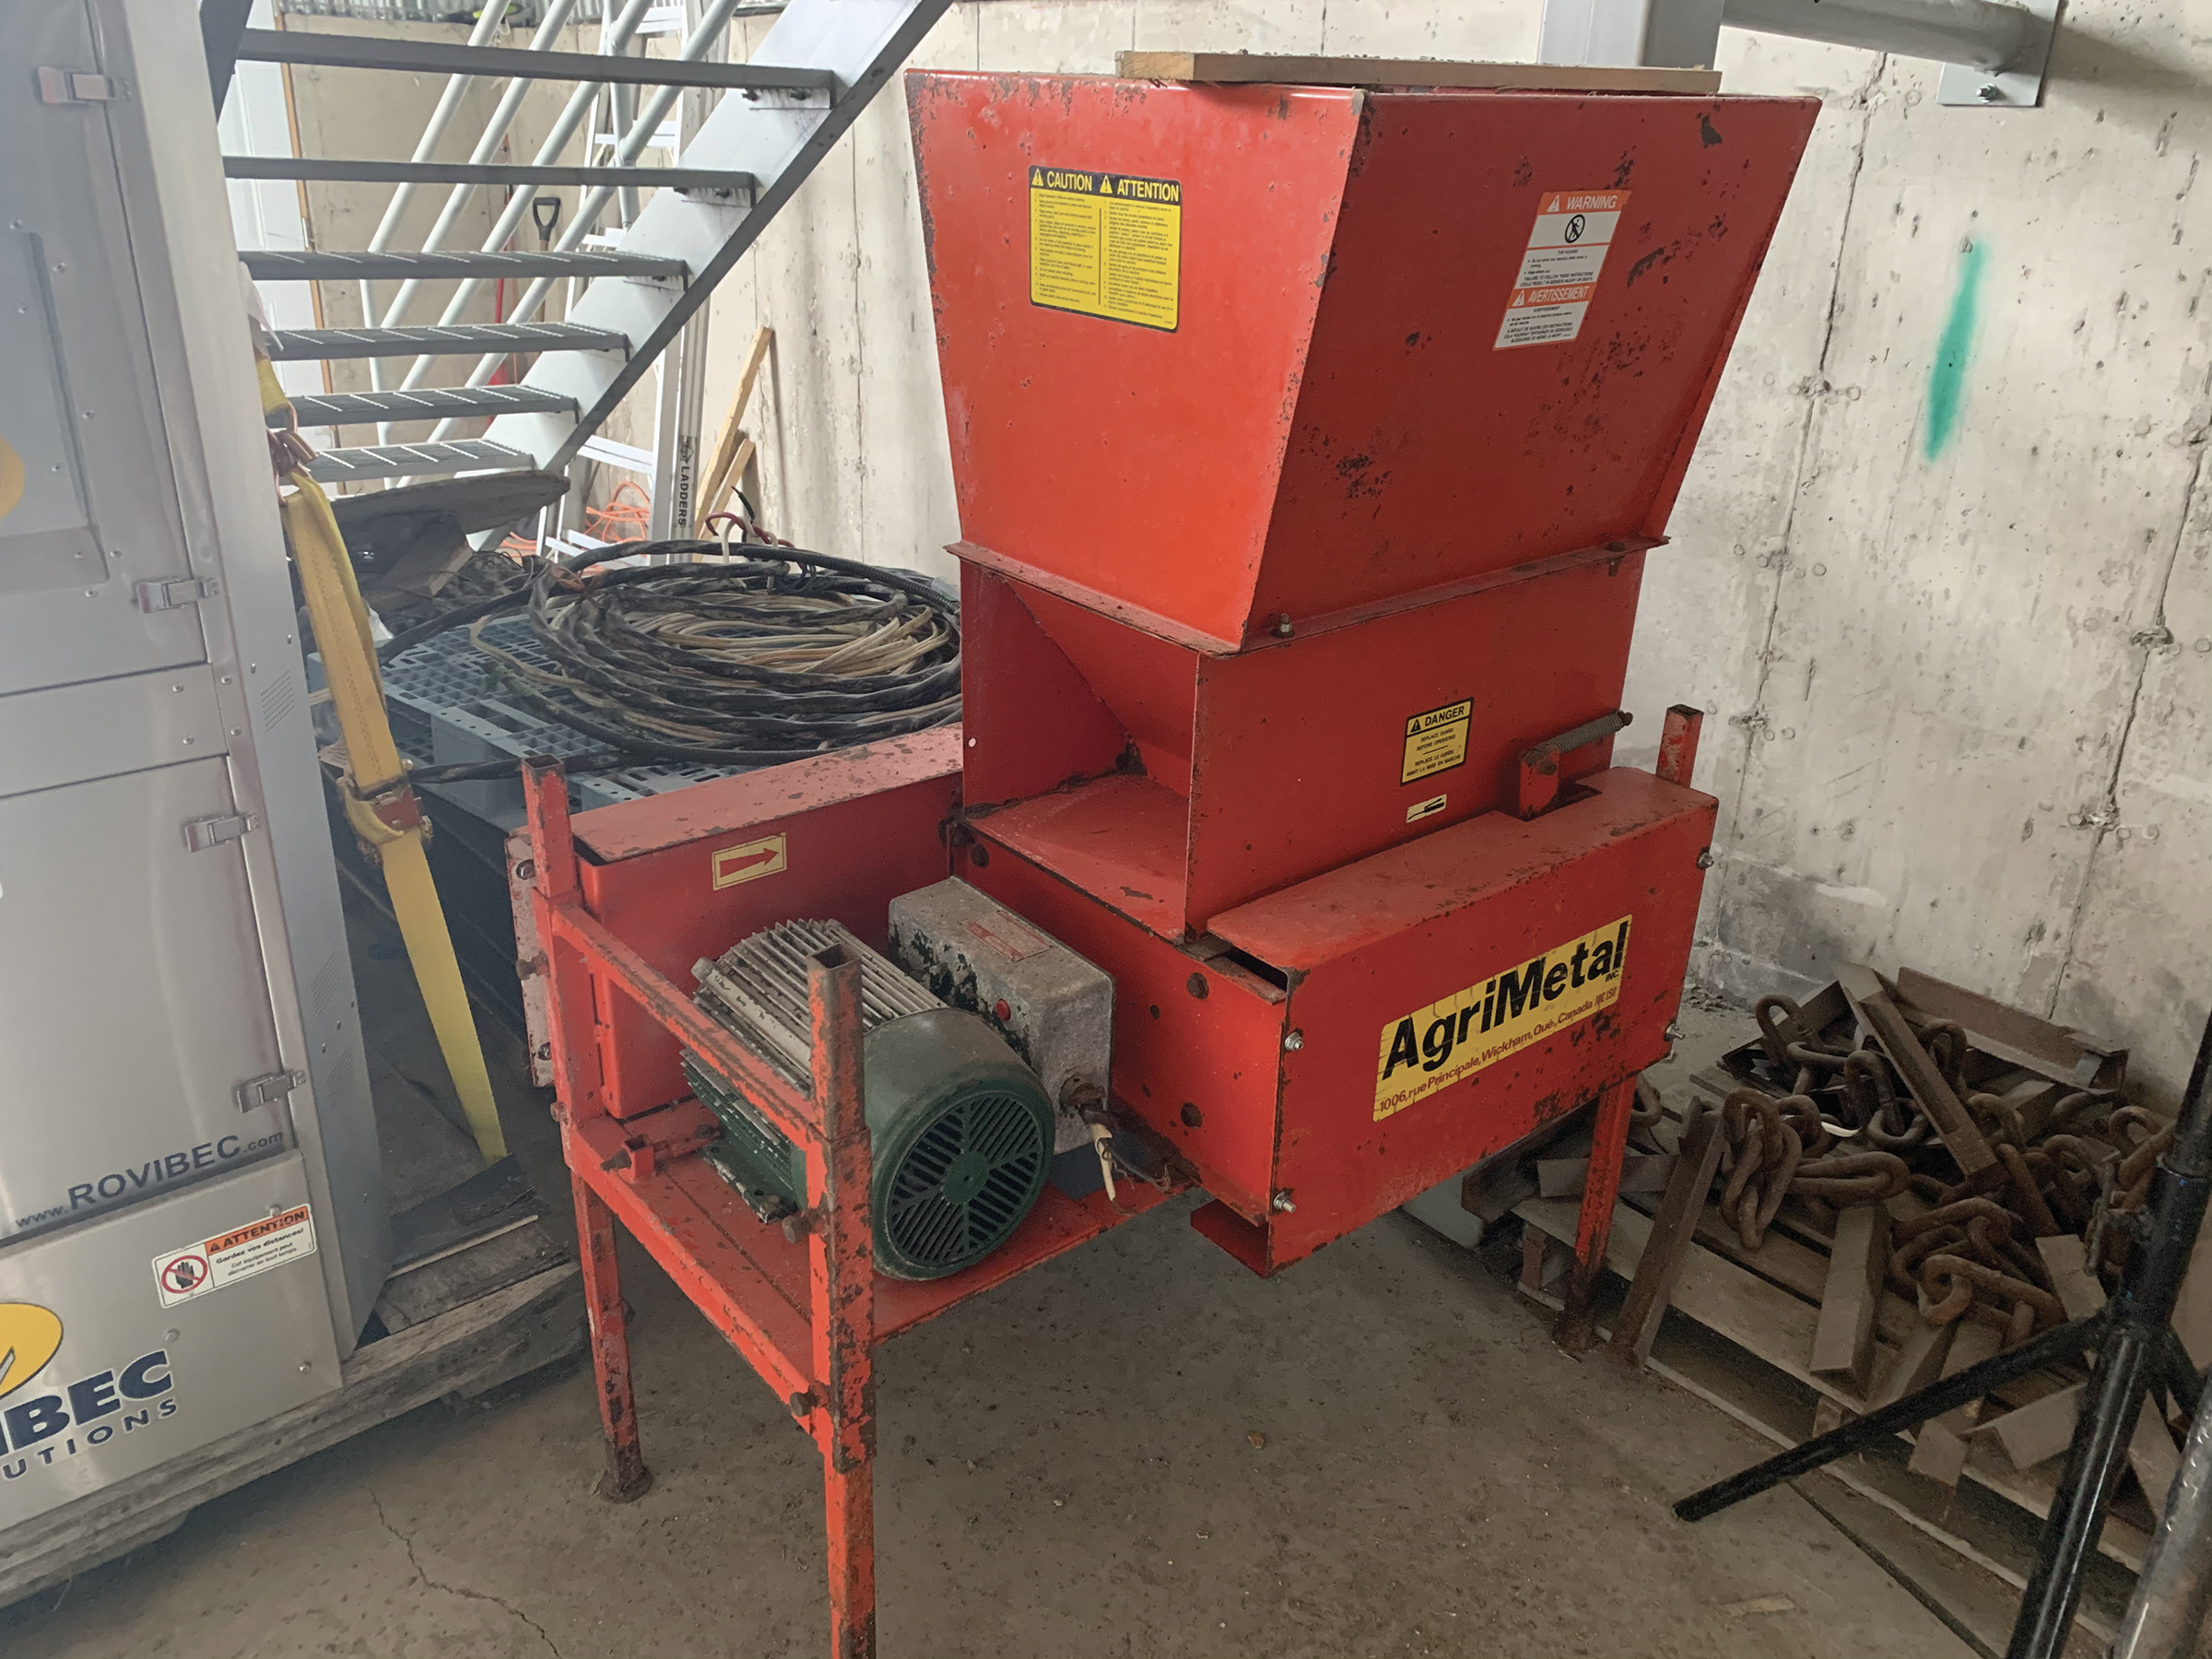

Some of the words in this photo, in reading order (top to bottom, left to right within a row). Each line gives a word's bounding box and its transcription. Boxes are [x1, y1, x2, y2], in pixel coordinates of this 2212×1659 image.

[1047, 171, 1092, 192] CAUTION
[1117, 179, 1179, 202] ATTENTION
[1567, 194, 1618, 210] WARNING
[1527, 286, 1591, 304] AVERTISSEMENT
[677, 465, 690, 526] LADDERS
[1424, 705, 1465, 727] DANGER
[1420, 732, 1439, 743] REPLACE
[1440, 727, 1454, 736] GUARD
[1417, 742, 1433, 752] BEFORE
[1382, 919, 1629, 1081] AgriMetal
[1408, 1083, 1428, 1100] rue
[1428, 1057, 1481, 1088] Principale,
[1481, 1031, 1534, 1063] Wickham,
[1558, 1000, 1593, 1024] Canada
[16, 1132, 284, 1229] www.ROVIBEC.com
[223, 1210, 305, 1248] ATTENTION
[216, 1250, 245, 1265] Gardez
[247, 1243, 262, 1253] vos
[279, 1241, 293, 1252] peut
[3, 1398, 177, 1478] UTIONS
